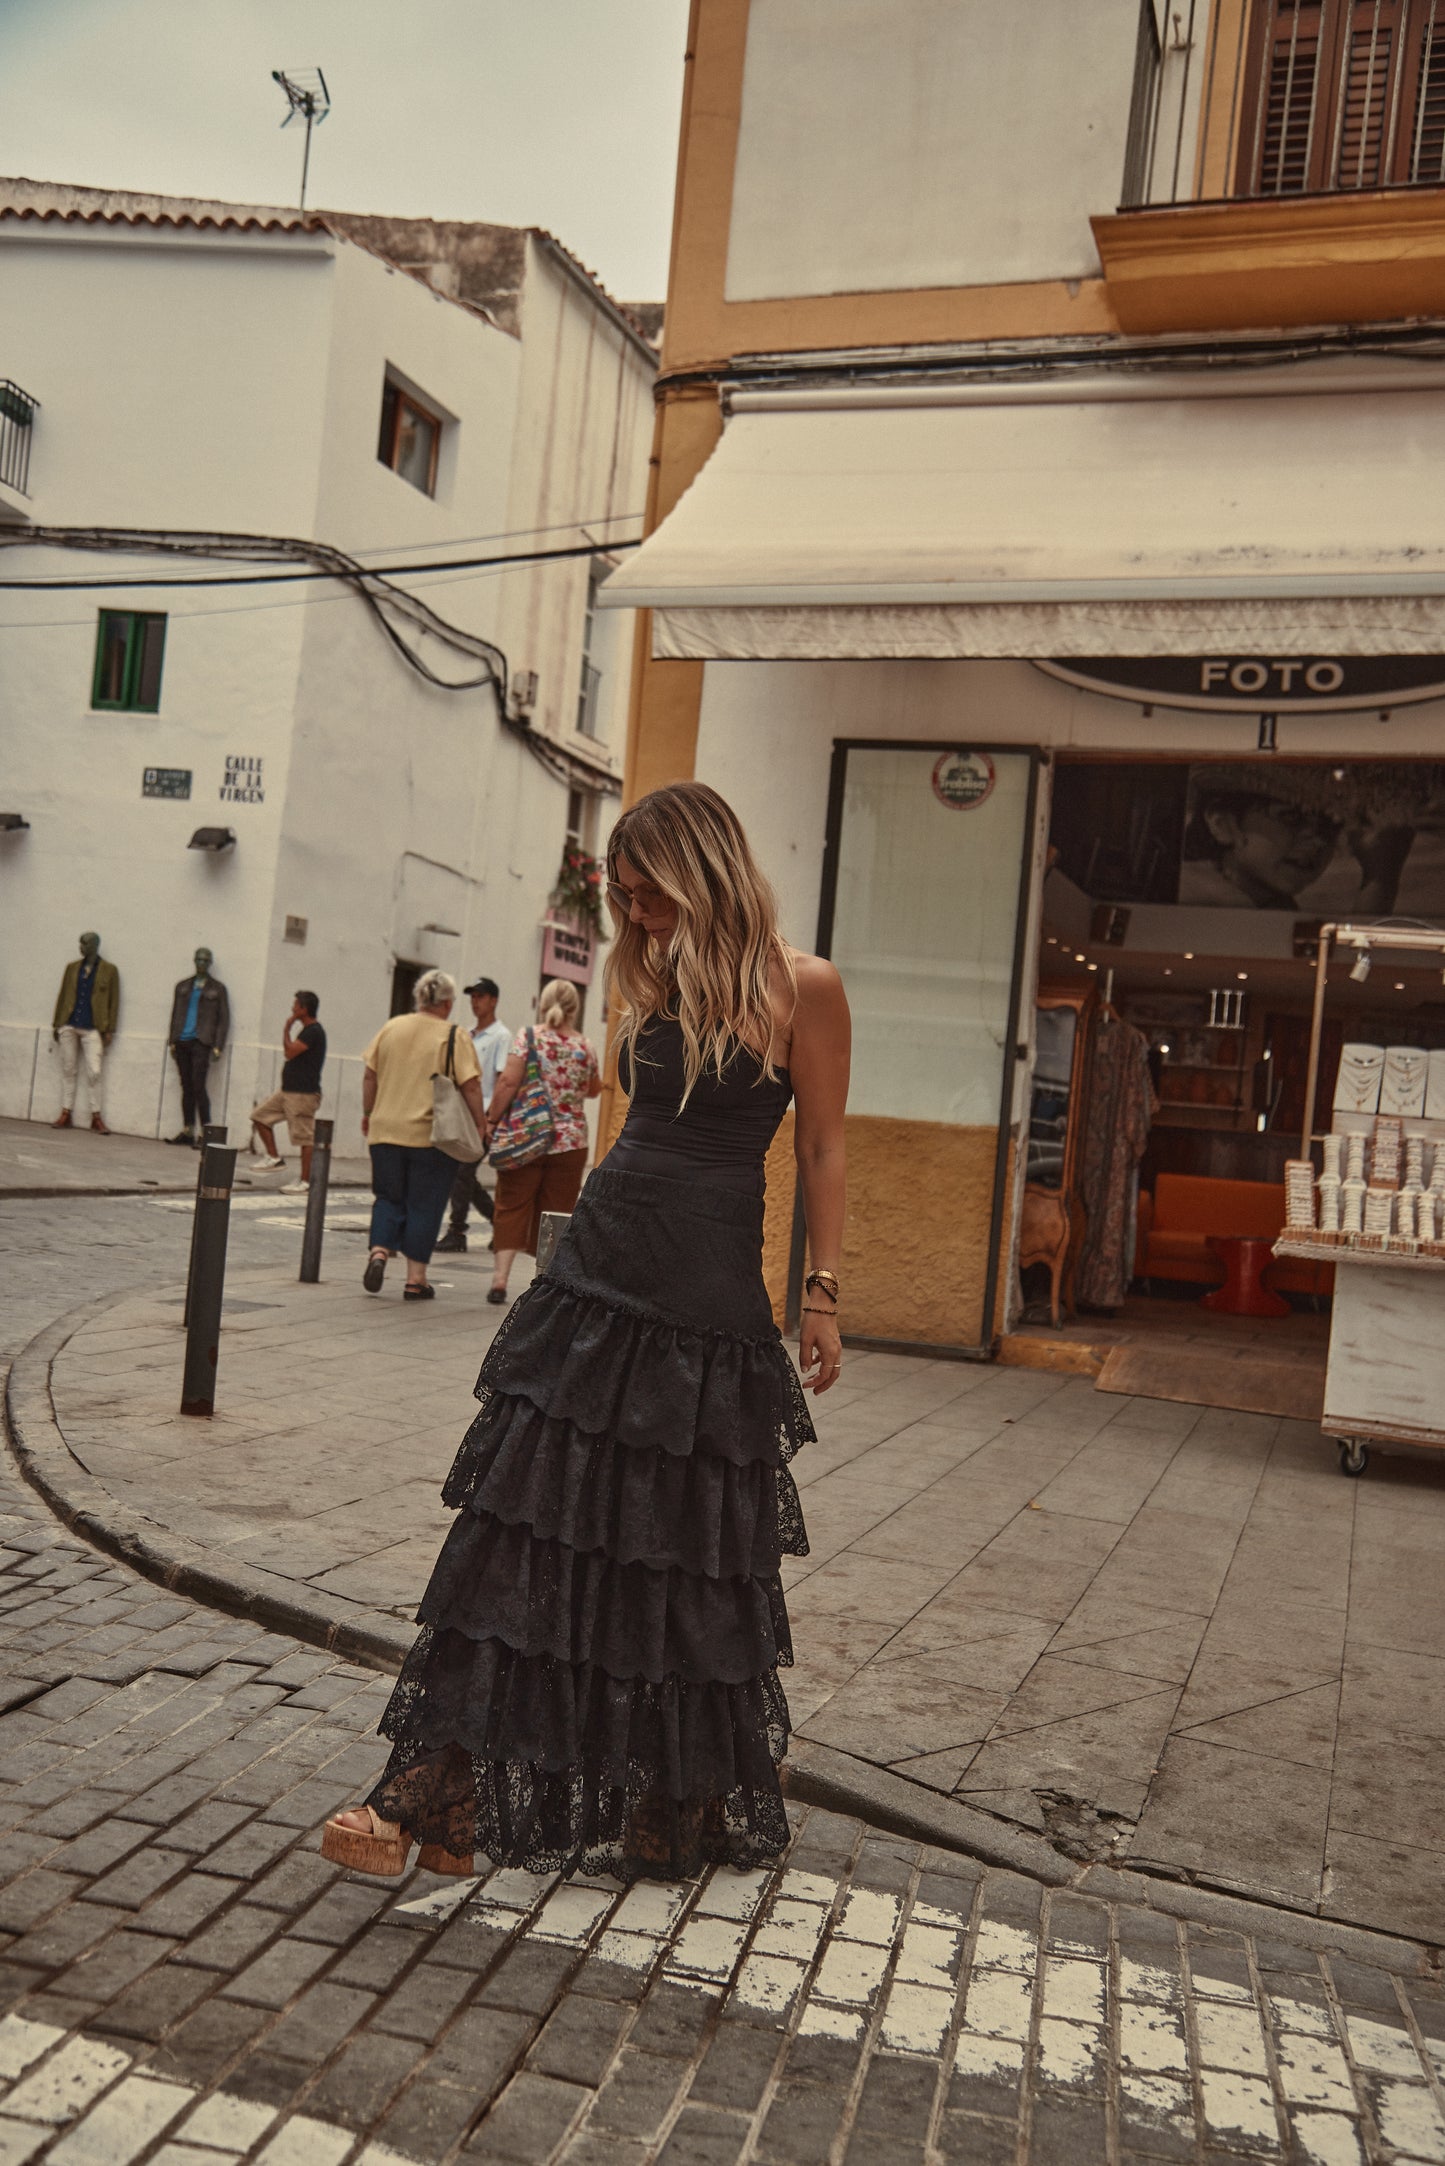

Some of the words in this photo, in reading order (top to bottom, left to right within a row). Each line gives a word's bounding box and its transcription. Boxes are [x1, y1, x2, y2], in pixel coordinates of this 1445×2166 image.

[1201, 660, 1345, 693] FOTO
[1261, 716, 1273, 747] 1
[225, 756, 263, 772] CALLE
[224, 772, 237, 786] DE
[246, 773, 261, 787] LA
[219, 787, 265, 803] VIRGEN
